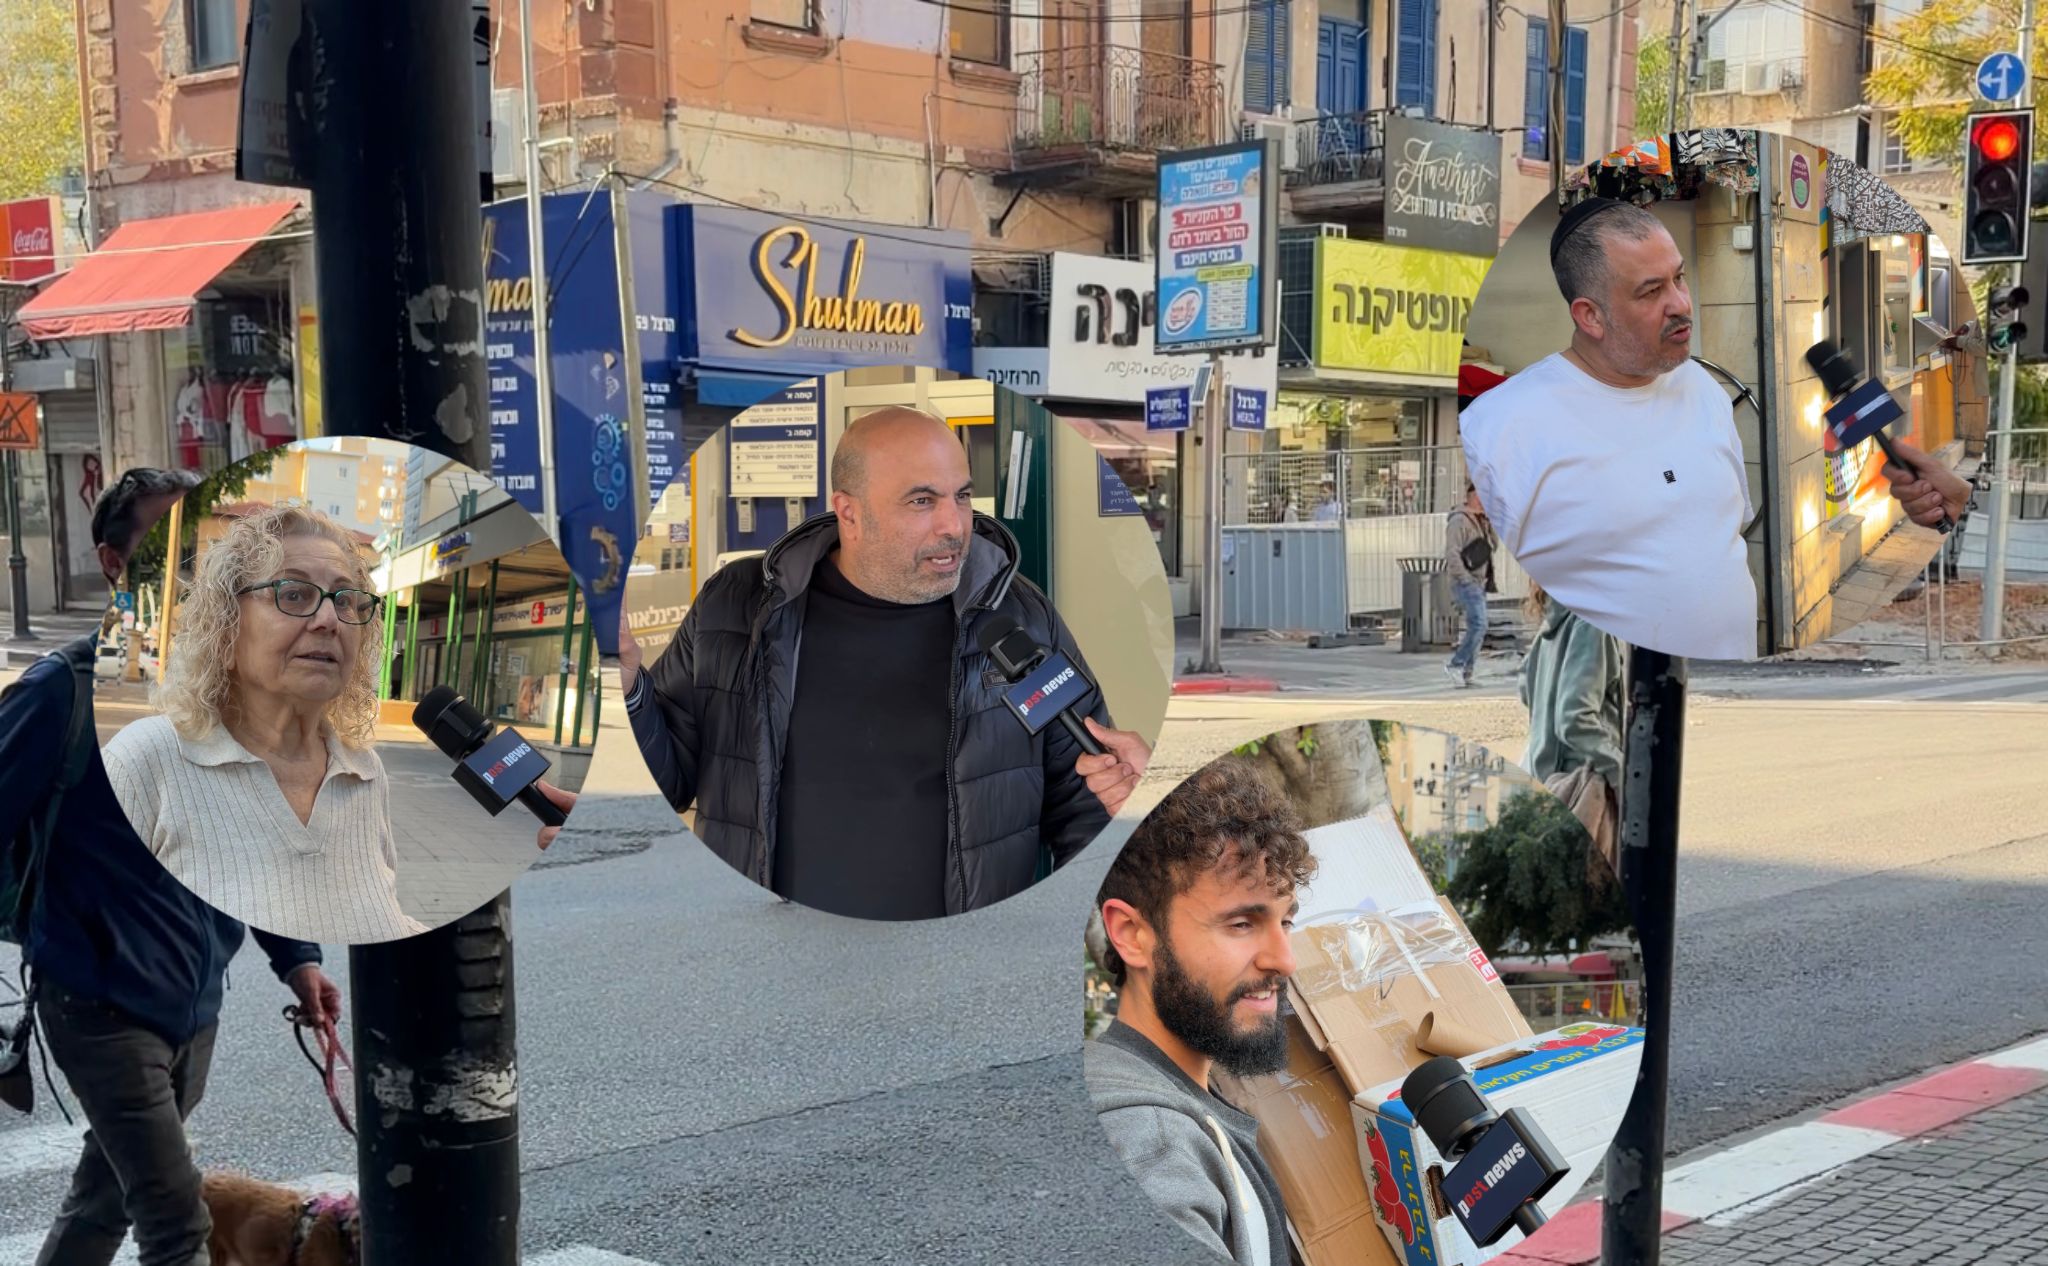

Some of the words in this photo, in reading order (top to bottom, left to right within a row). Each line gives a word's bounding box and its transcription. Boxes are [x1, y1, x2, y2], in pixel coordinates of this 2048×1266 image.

[734, 225, 925, 347] Shulman
[650, 314, 676, 333] הרצל
[987, 367, 1041, 386] חרוזינה
[1237, 392, 1258, 410] הרצל
